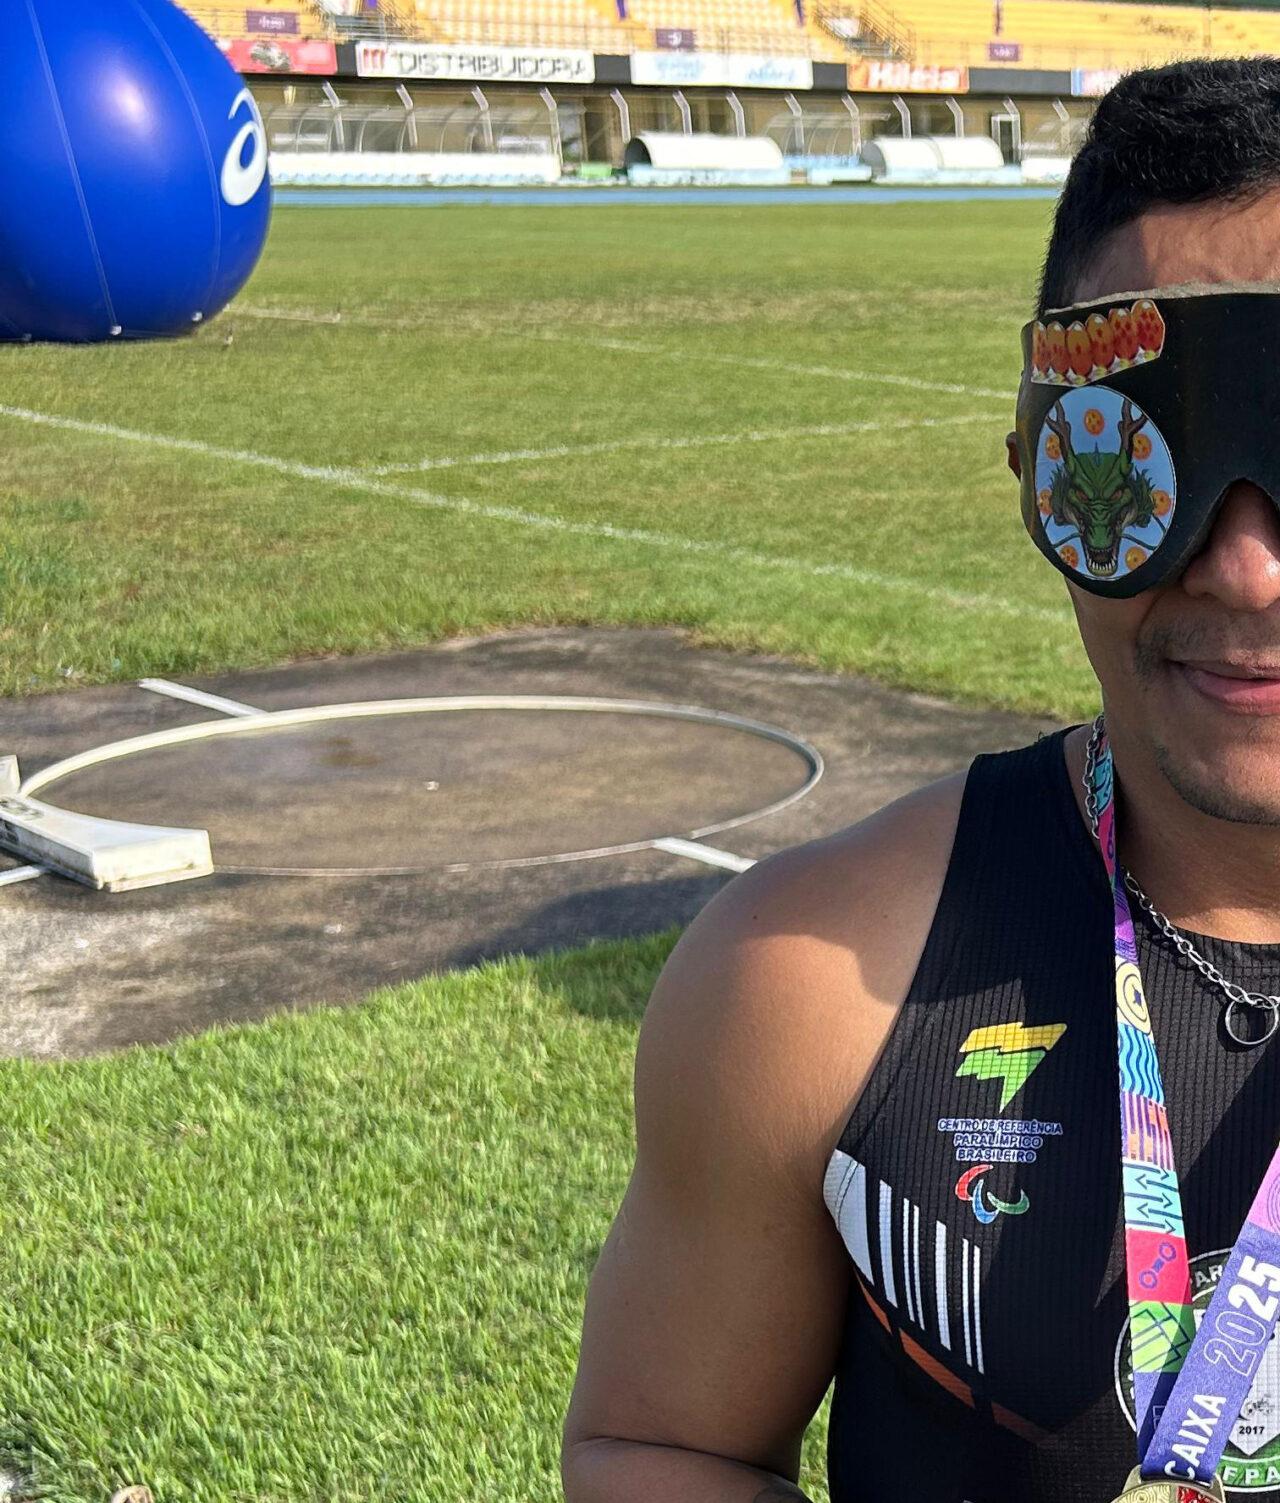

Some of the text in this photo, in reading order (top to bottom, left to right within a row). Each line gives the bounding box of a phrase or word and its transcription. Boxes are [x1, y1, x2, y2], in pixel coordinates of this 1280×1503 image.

[937, 1118, 981, 1132] CENTRO
[980, 1119, 996, 1133] DE
[953, 1132, 1044, 1150] PARALÍMPICO
[956, 1147, 1037, 1163] BRASILEIRO
[1163, 1393, 1228, 1482] CAIXA
[1239, 1425, 1265, 1435] 2017
